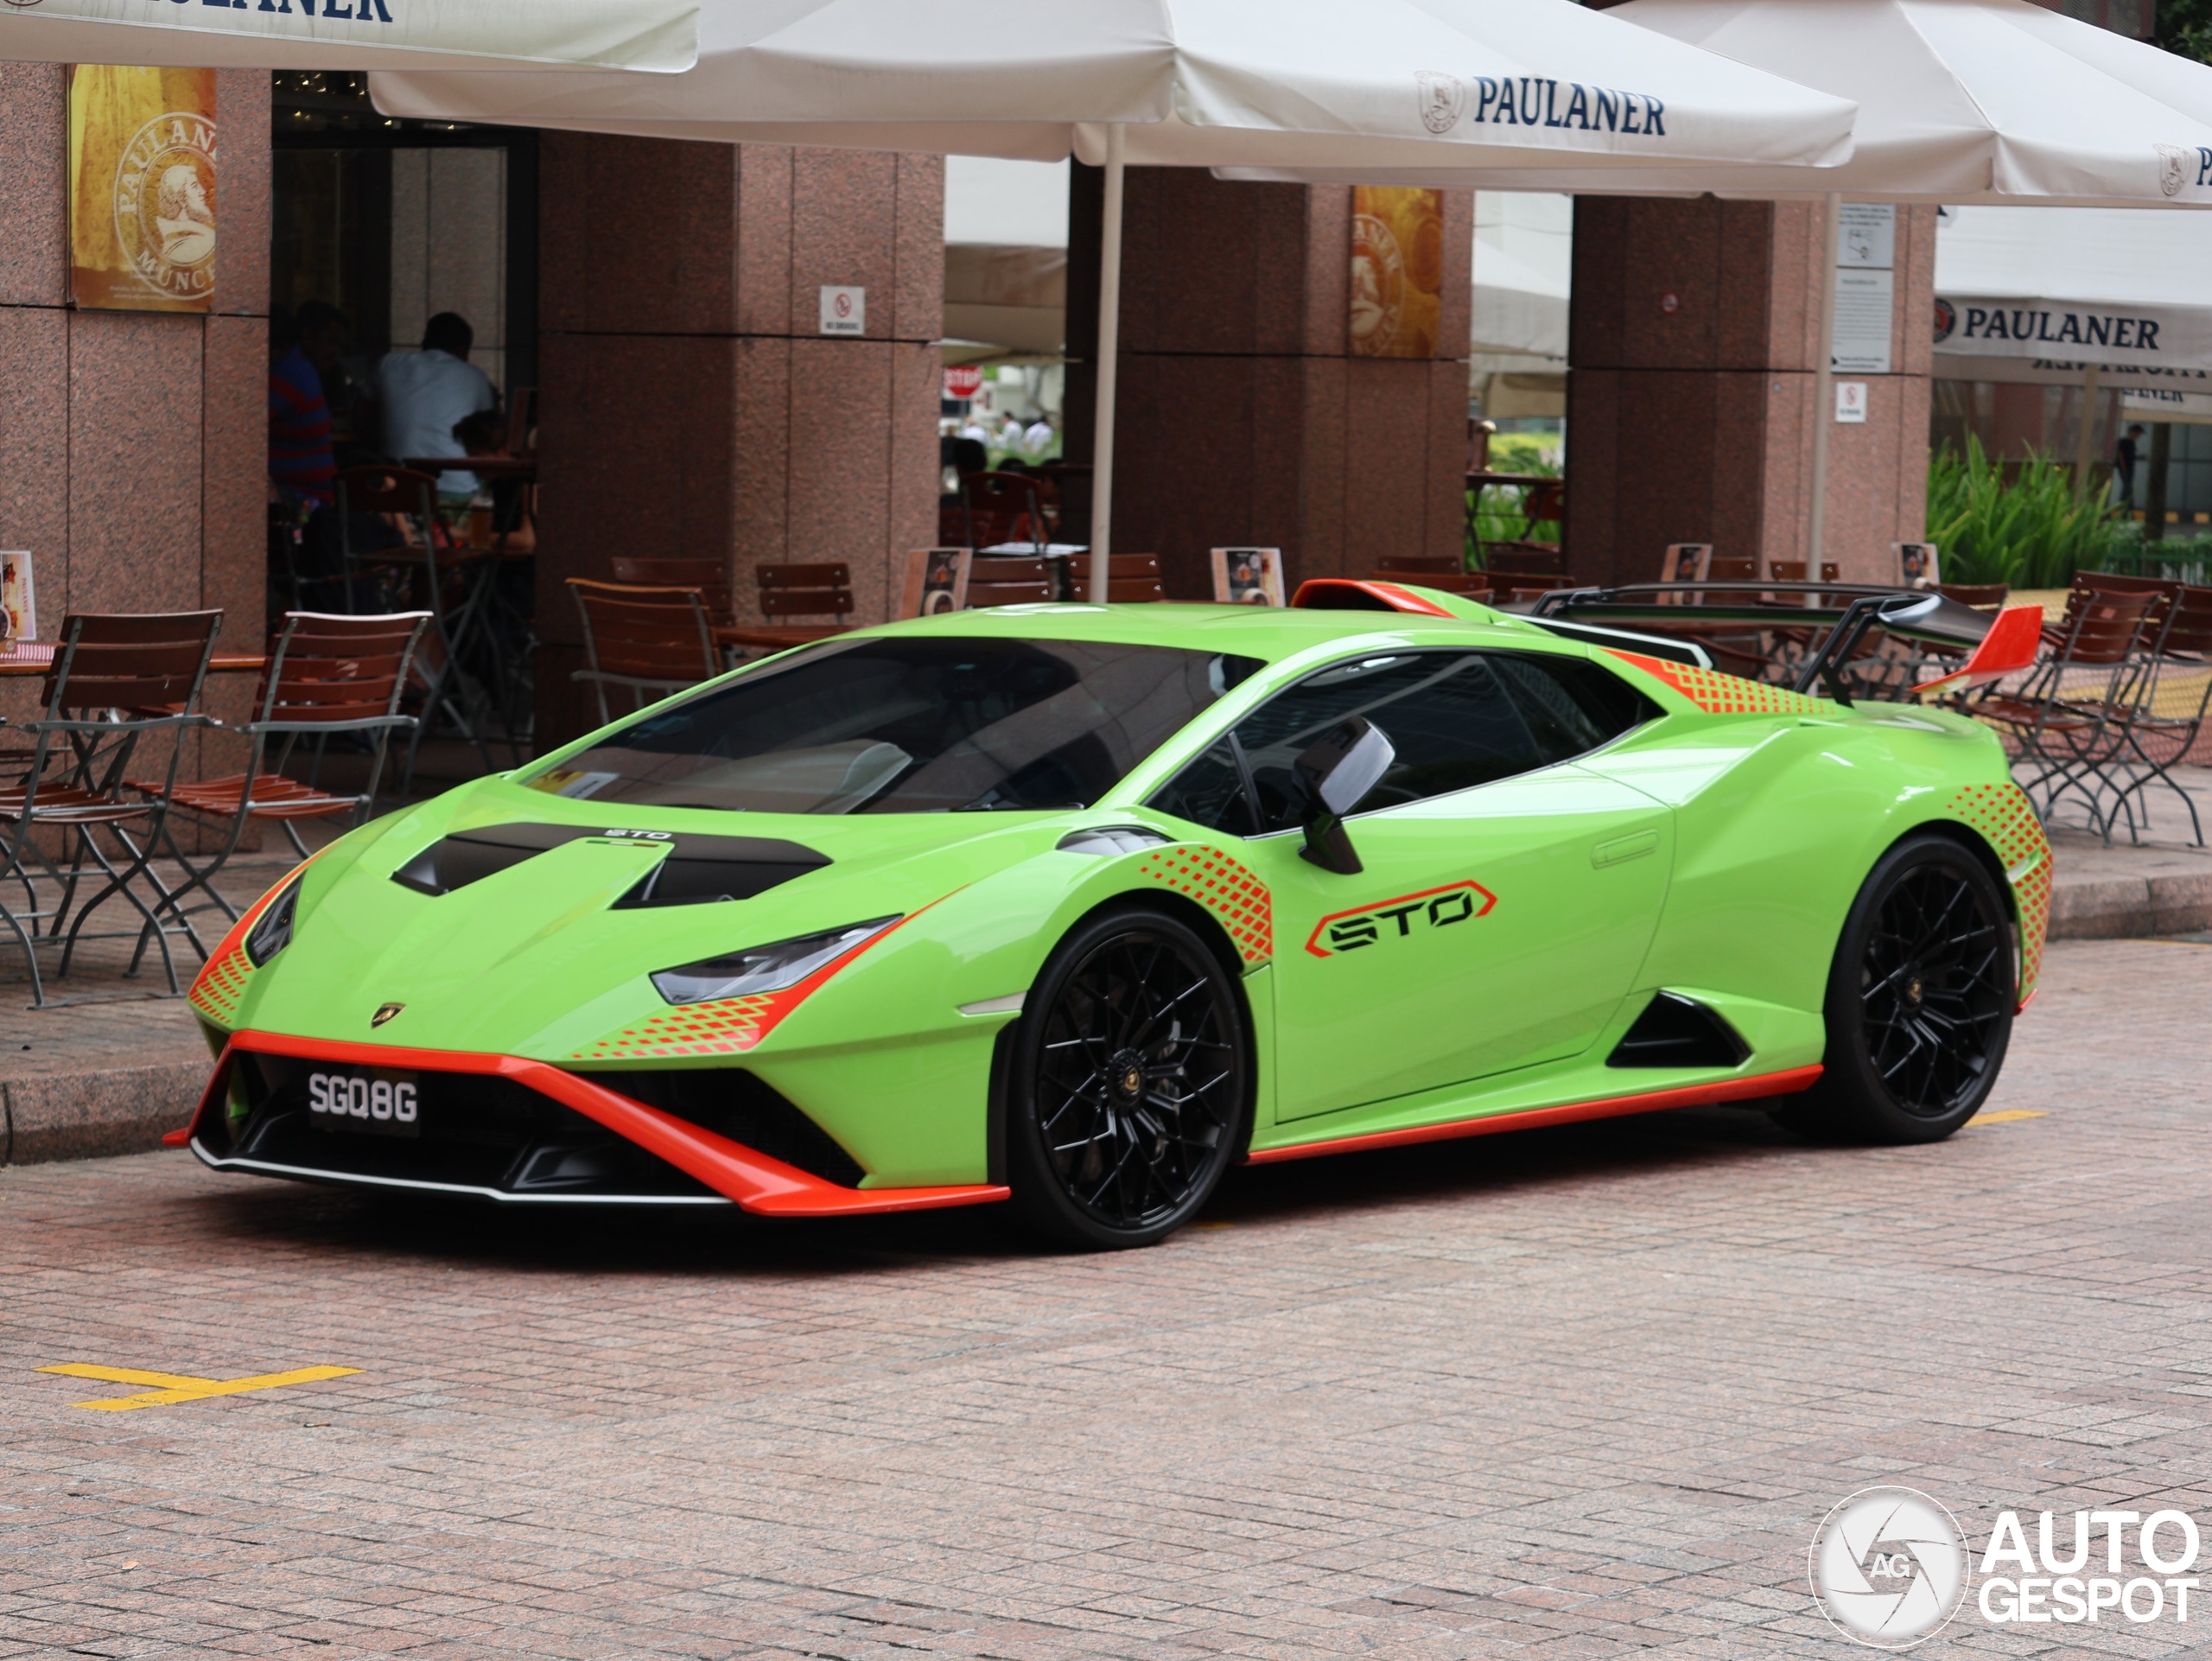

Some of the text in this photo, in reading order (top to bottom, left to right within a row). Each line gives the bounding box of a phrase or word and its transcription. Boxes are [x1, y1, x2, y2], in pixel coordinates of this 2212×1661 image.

[1472, 75, 1666, 136] PAULANER
[118, 119, 216, 214] PAULAN
[2195, 146, 2212, 186] P
[1963, 308, 2159, 350] PAULANER
[604, 829, 672, 840] STO
[1330, 891, 1473, 951] STO
[308, 1072, 417, 1123] SGQ8G
